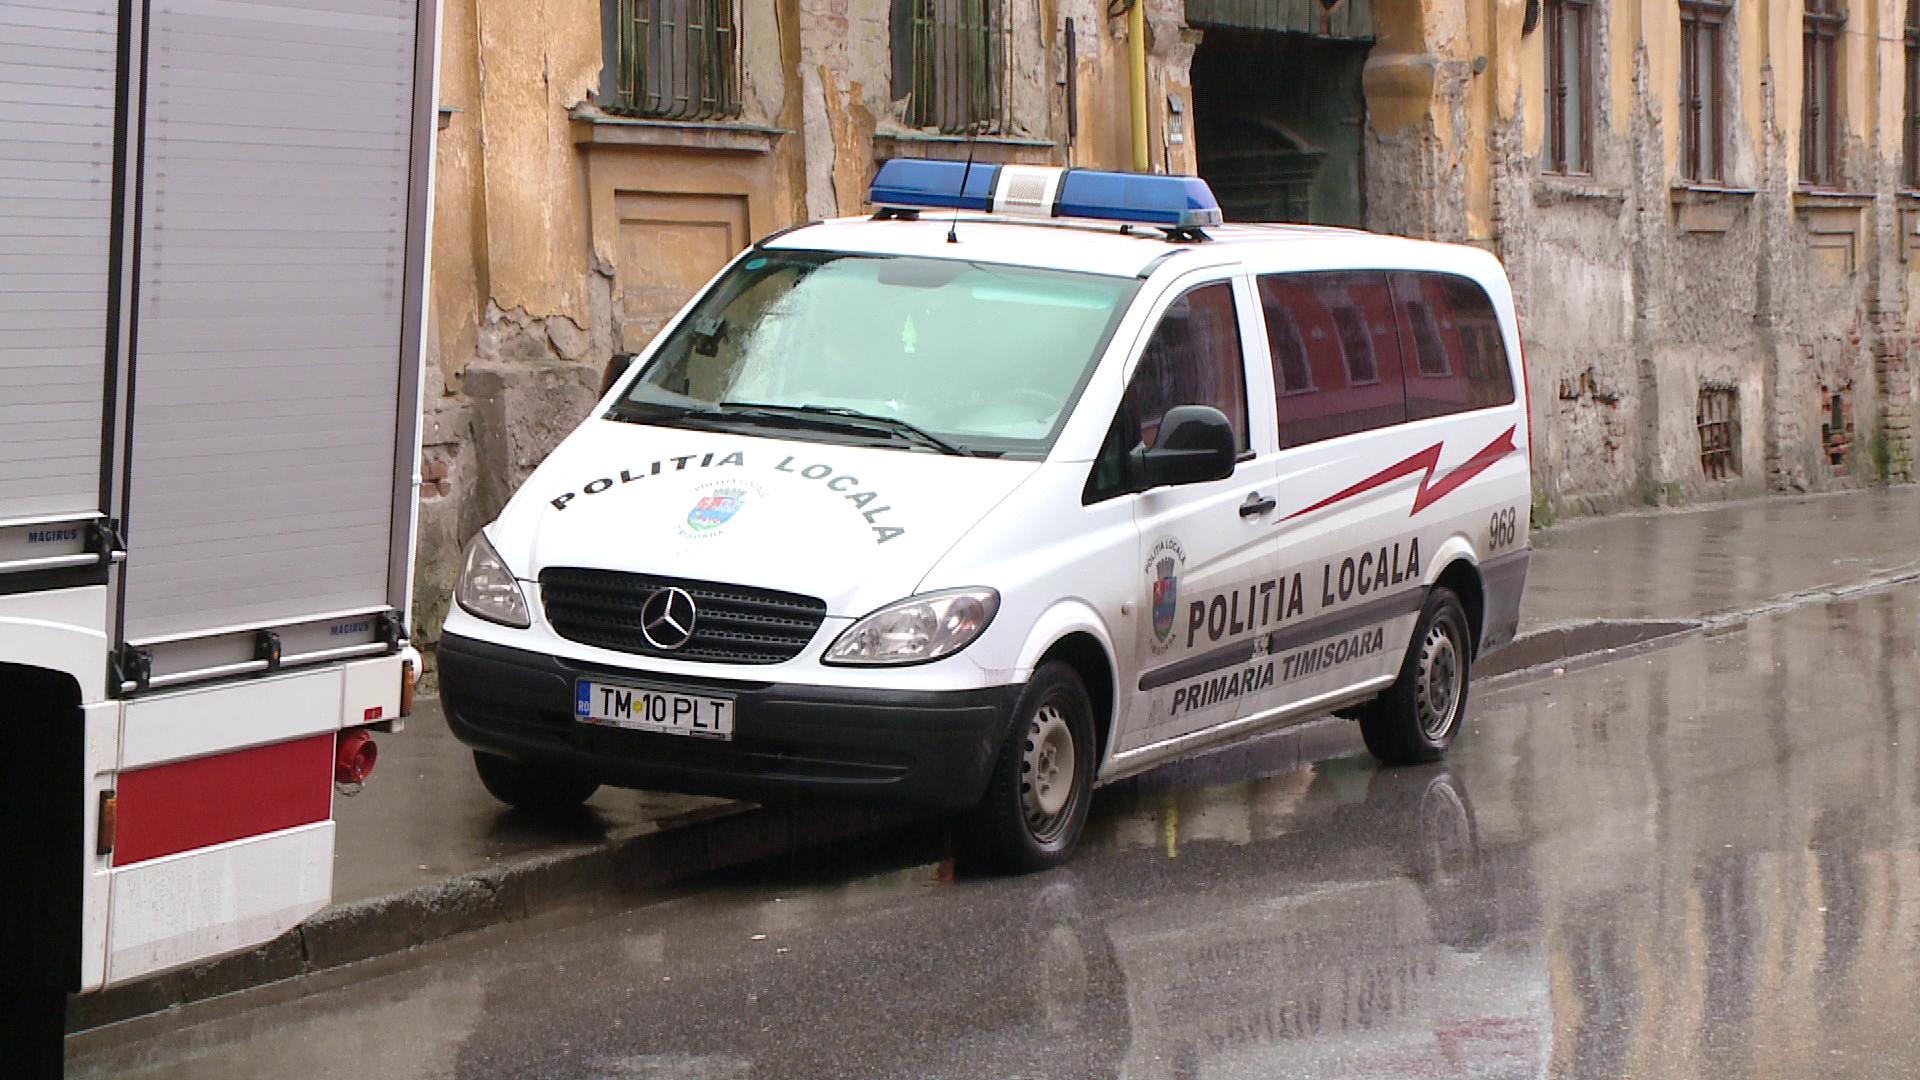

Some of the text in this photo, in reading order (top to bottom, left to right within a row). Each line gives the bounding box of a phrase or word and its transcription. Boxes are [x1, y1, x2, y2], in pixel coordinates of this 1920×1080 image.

[550, 451, 905, 545] POLITIA LOCALA
[1488, 505, 1517, 552] 968
[28, 528, 78, 544] MAGIRUS
[1186, 536, 1420, 649] POLITIA LOCALA
[1171, 626, 1384, 716] PRIMARIA TIMISOARA
[600, 687, 632, 719] TM
[642, 693, 667, 722] 10
[673, 697, 724, 729] PLT
